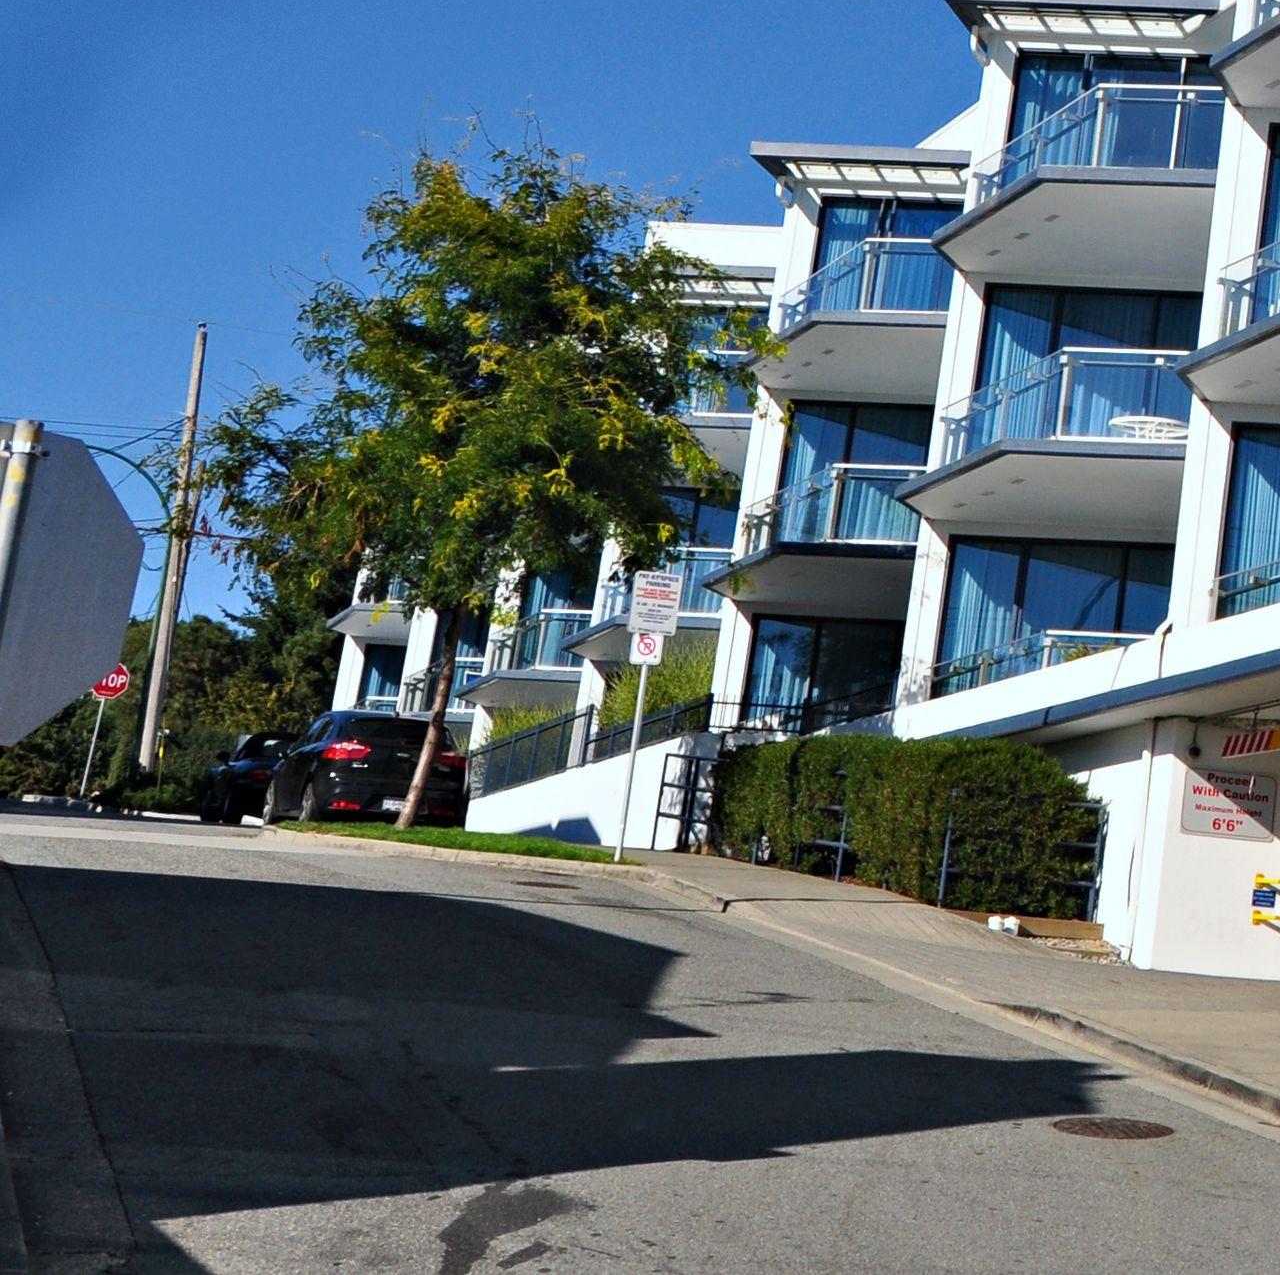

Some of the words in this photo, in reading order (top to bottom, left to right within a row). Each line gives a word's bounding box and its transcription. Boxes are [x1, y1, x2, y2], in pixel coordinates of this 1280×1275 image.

[1207, 773, 1256, 786] Proceed
[1192, 785, 1219, 797] With
[1223, 789, 1269, 802] Caution
[1195, 803, 1233, 813] Maximum
[1236, 808, 1263, 817] Height
